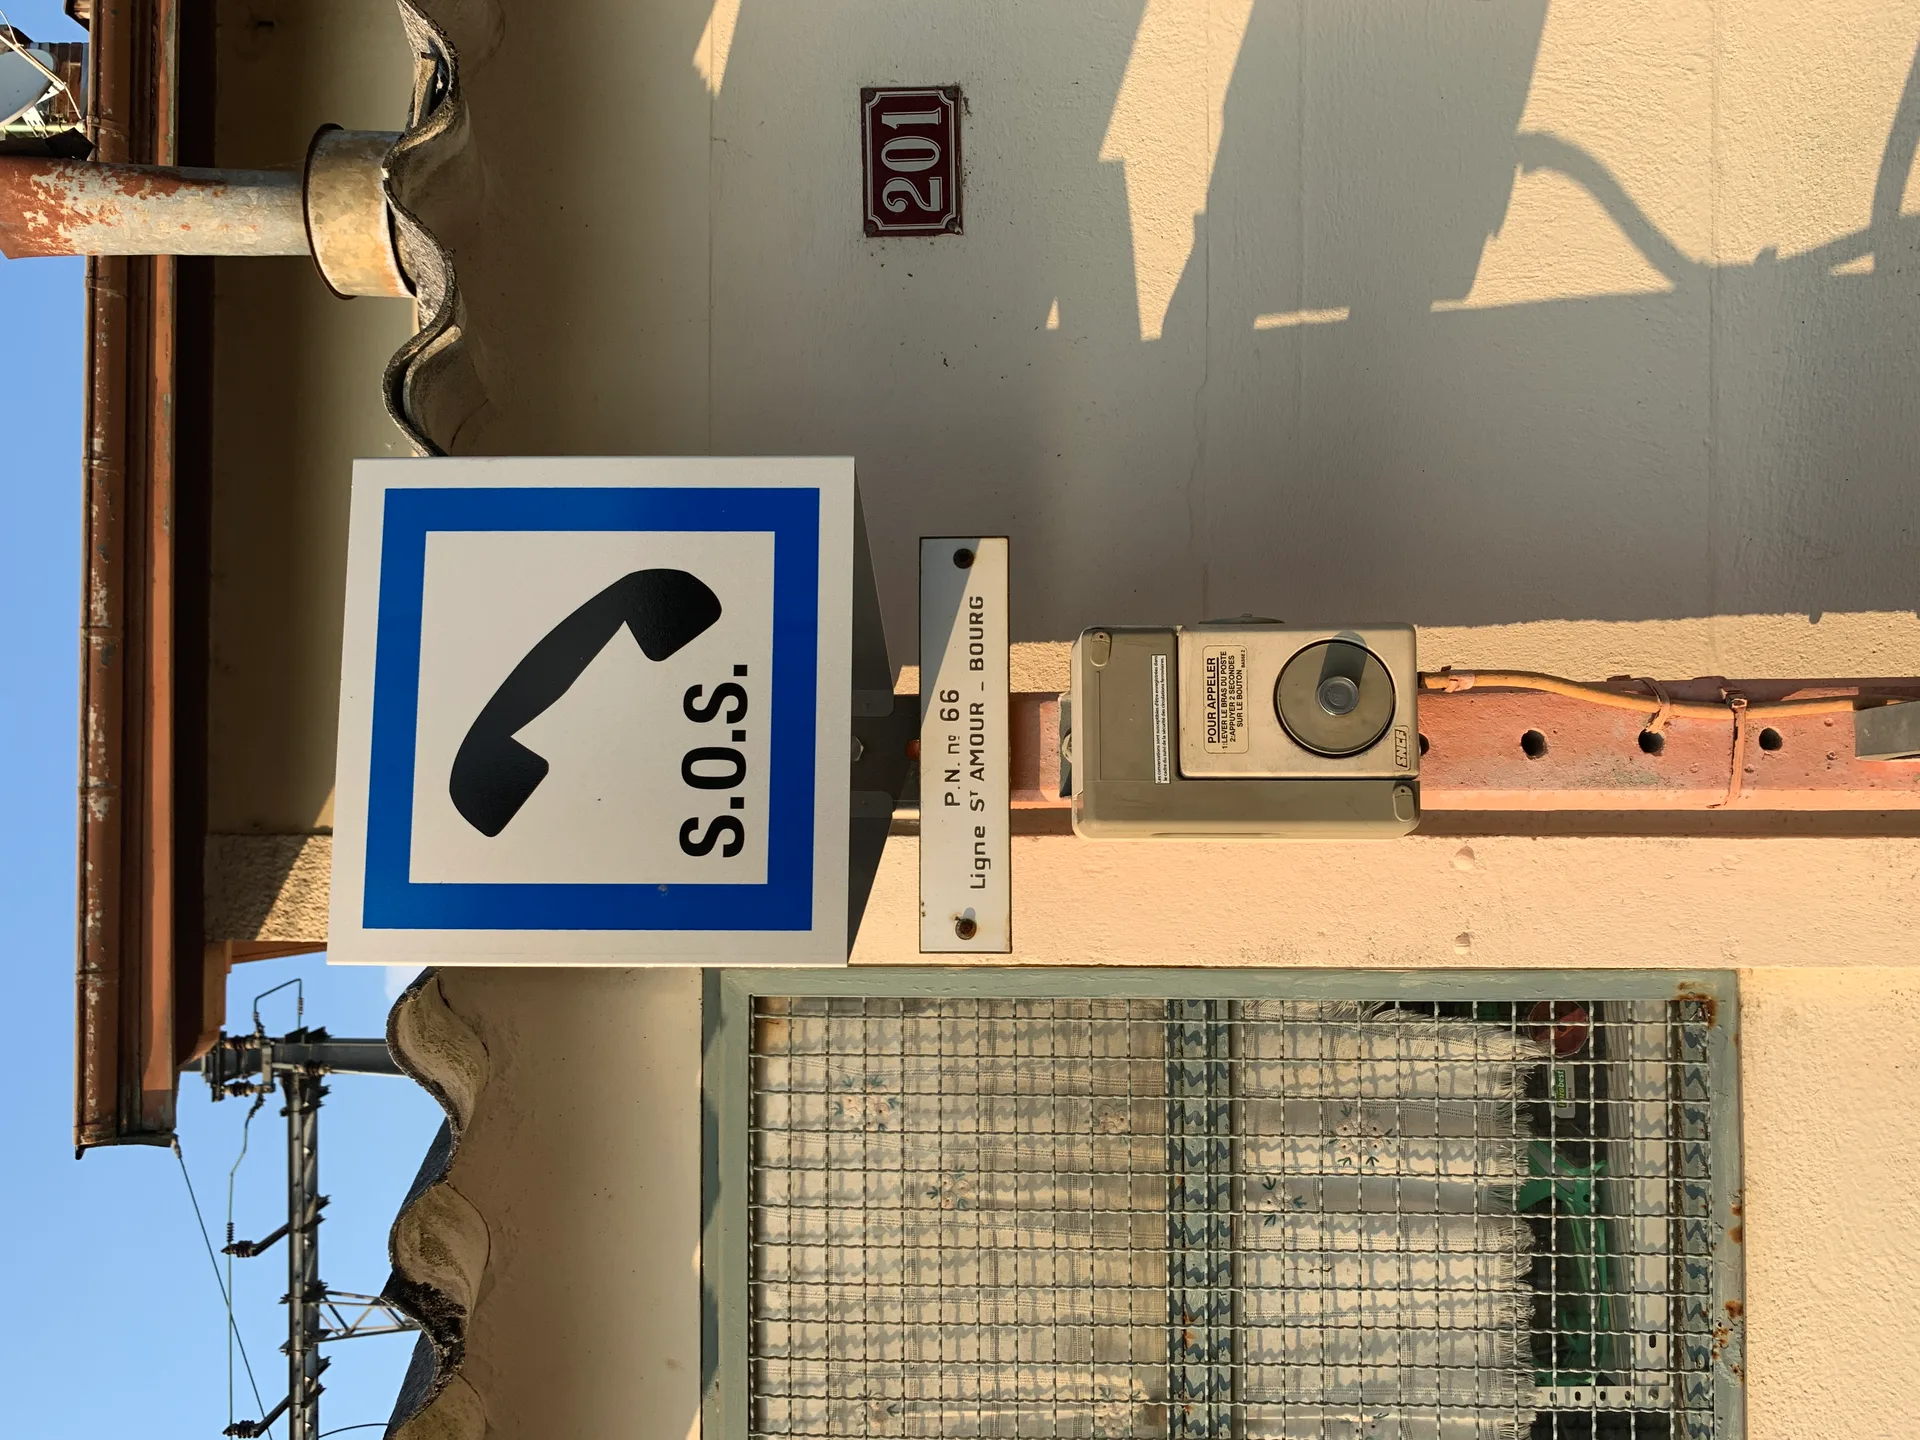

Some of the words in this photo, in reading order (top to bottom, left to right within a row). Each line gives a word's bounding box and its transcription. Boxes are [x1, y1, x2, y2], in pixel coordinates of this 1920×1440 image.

[881, 107, 943, 213] 201
[968, 595, 984, 671] BOURG
[1207, 658, 1216, 709] APPELER
[1220, 676, 1227, 686] DU
[940, 688, 960, 722] 66
[1221, 710, 1227, 718] LE
[1236, 702, 1243, 710] LE
[969, 702, 985, 781] AMOUR
[1208, 712, 1216, 743] POUR
[1395, 729, 1407, 767] SNCF
[679, 665, 748, 858] S.O.S.
[944, 762, 961, 806] P.N.
[969, 825, 991, 889] Ligne
